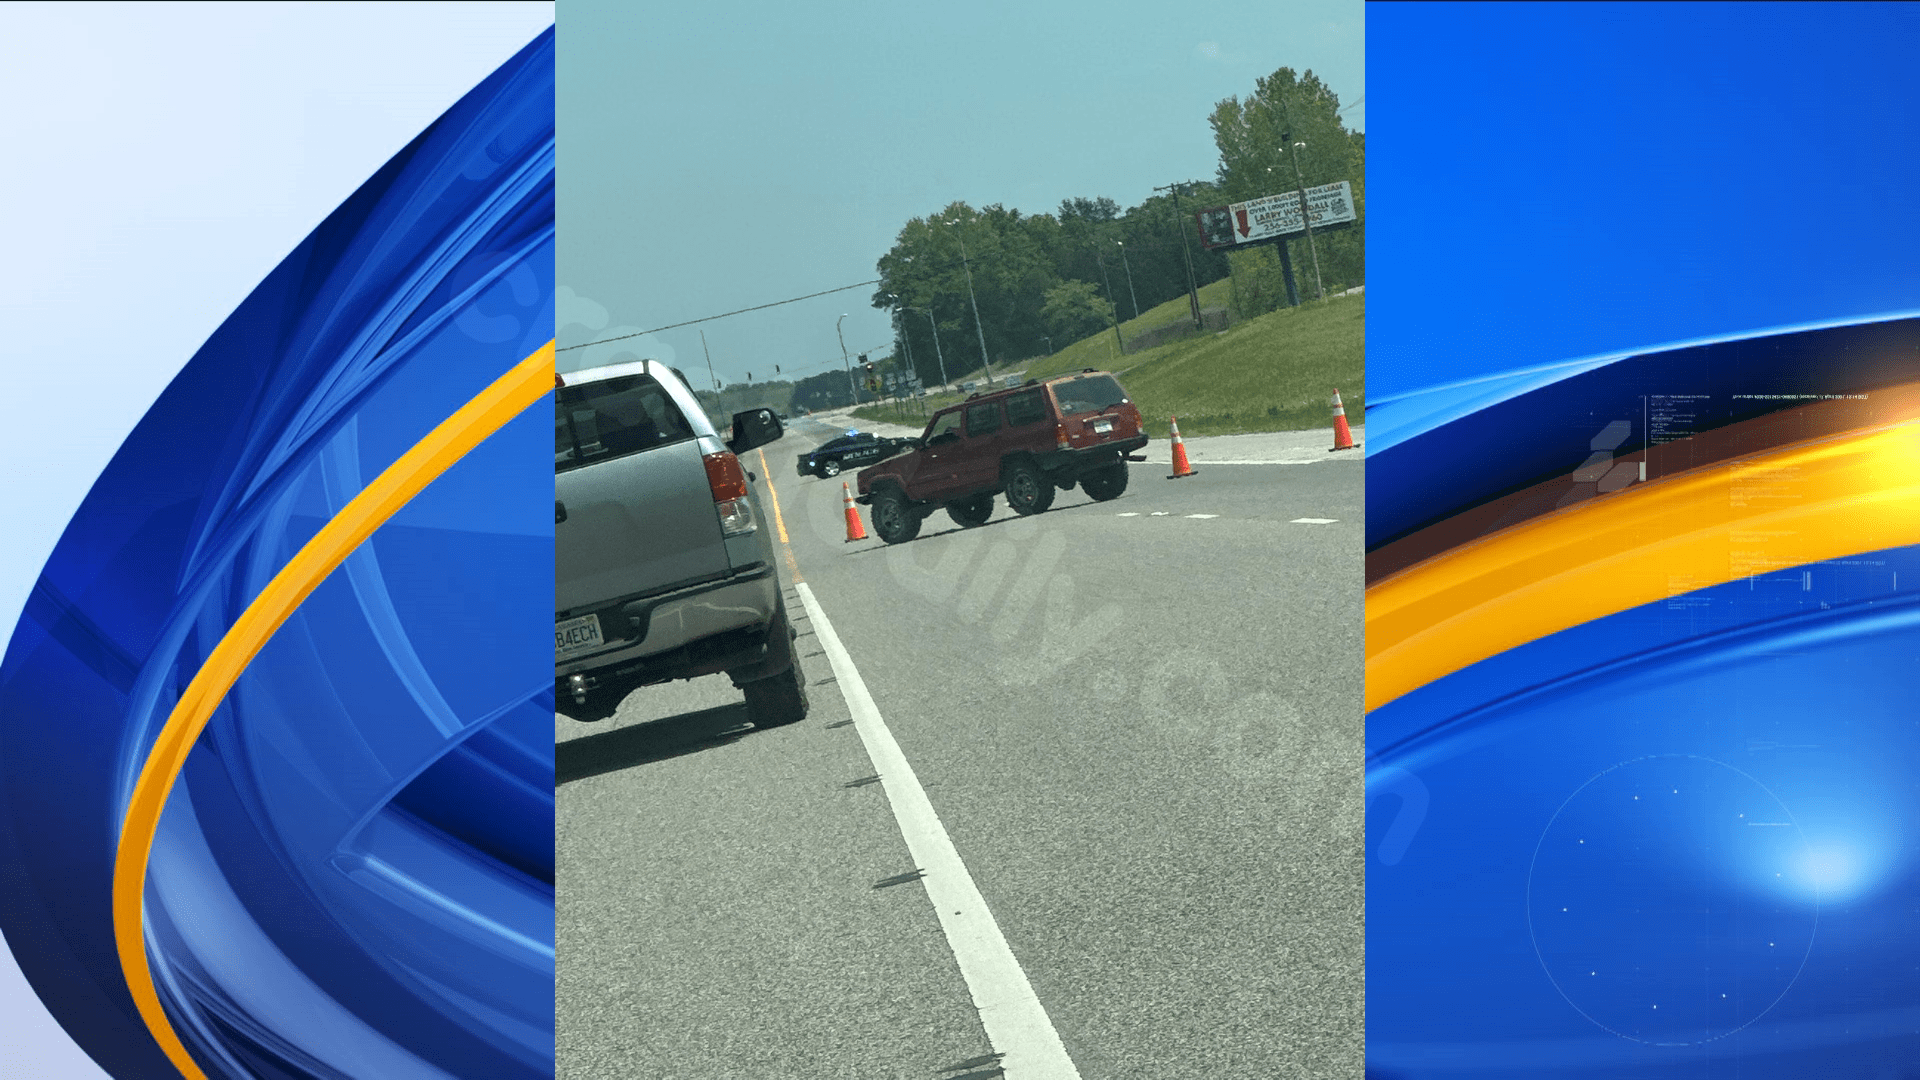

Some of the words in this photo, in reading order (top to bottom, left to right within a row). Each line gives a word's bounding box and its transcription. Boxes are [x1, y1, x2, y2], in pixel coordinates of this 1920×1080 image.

[1273, 191, 1307, 202] BUILDIN
[1323, 183, 1344, 192] LEASE
[1255, 210, 1281, 222] LARRY
[1283, 202, 1329, 215] WODALL
